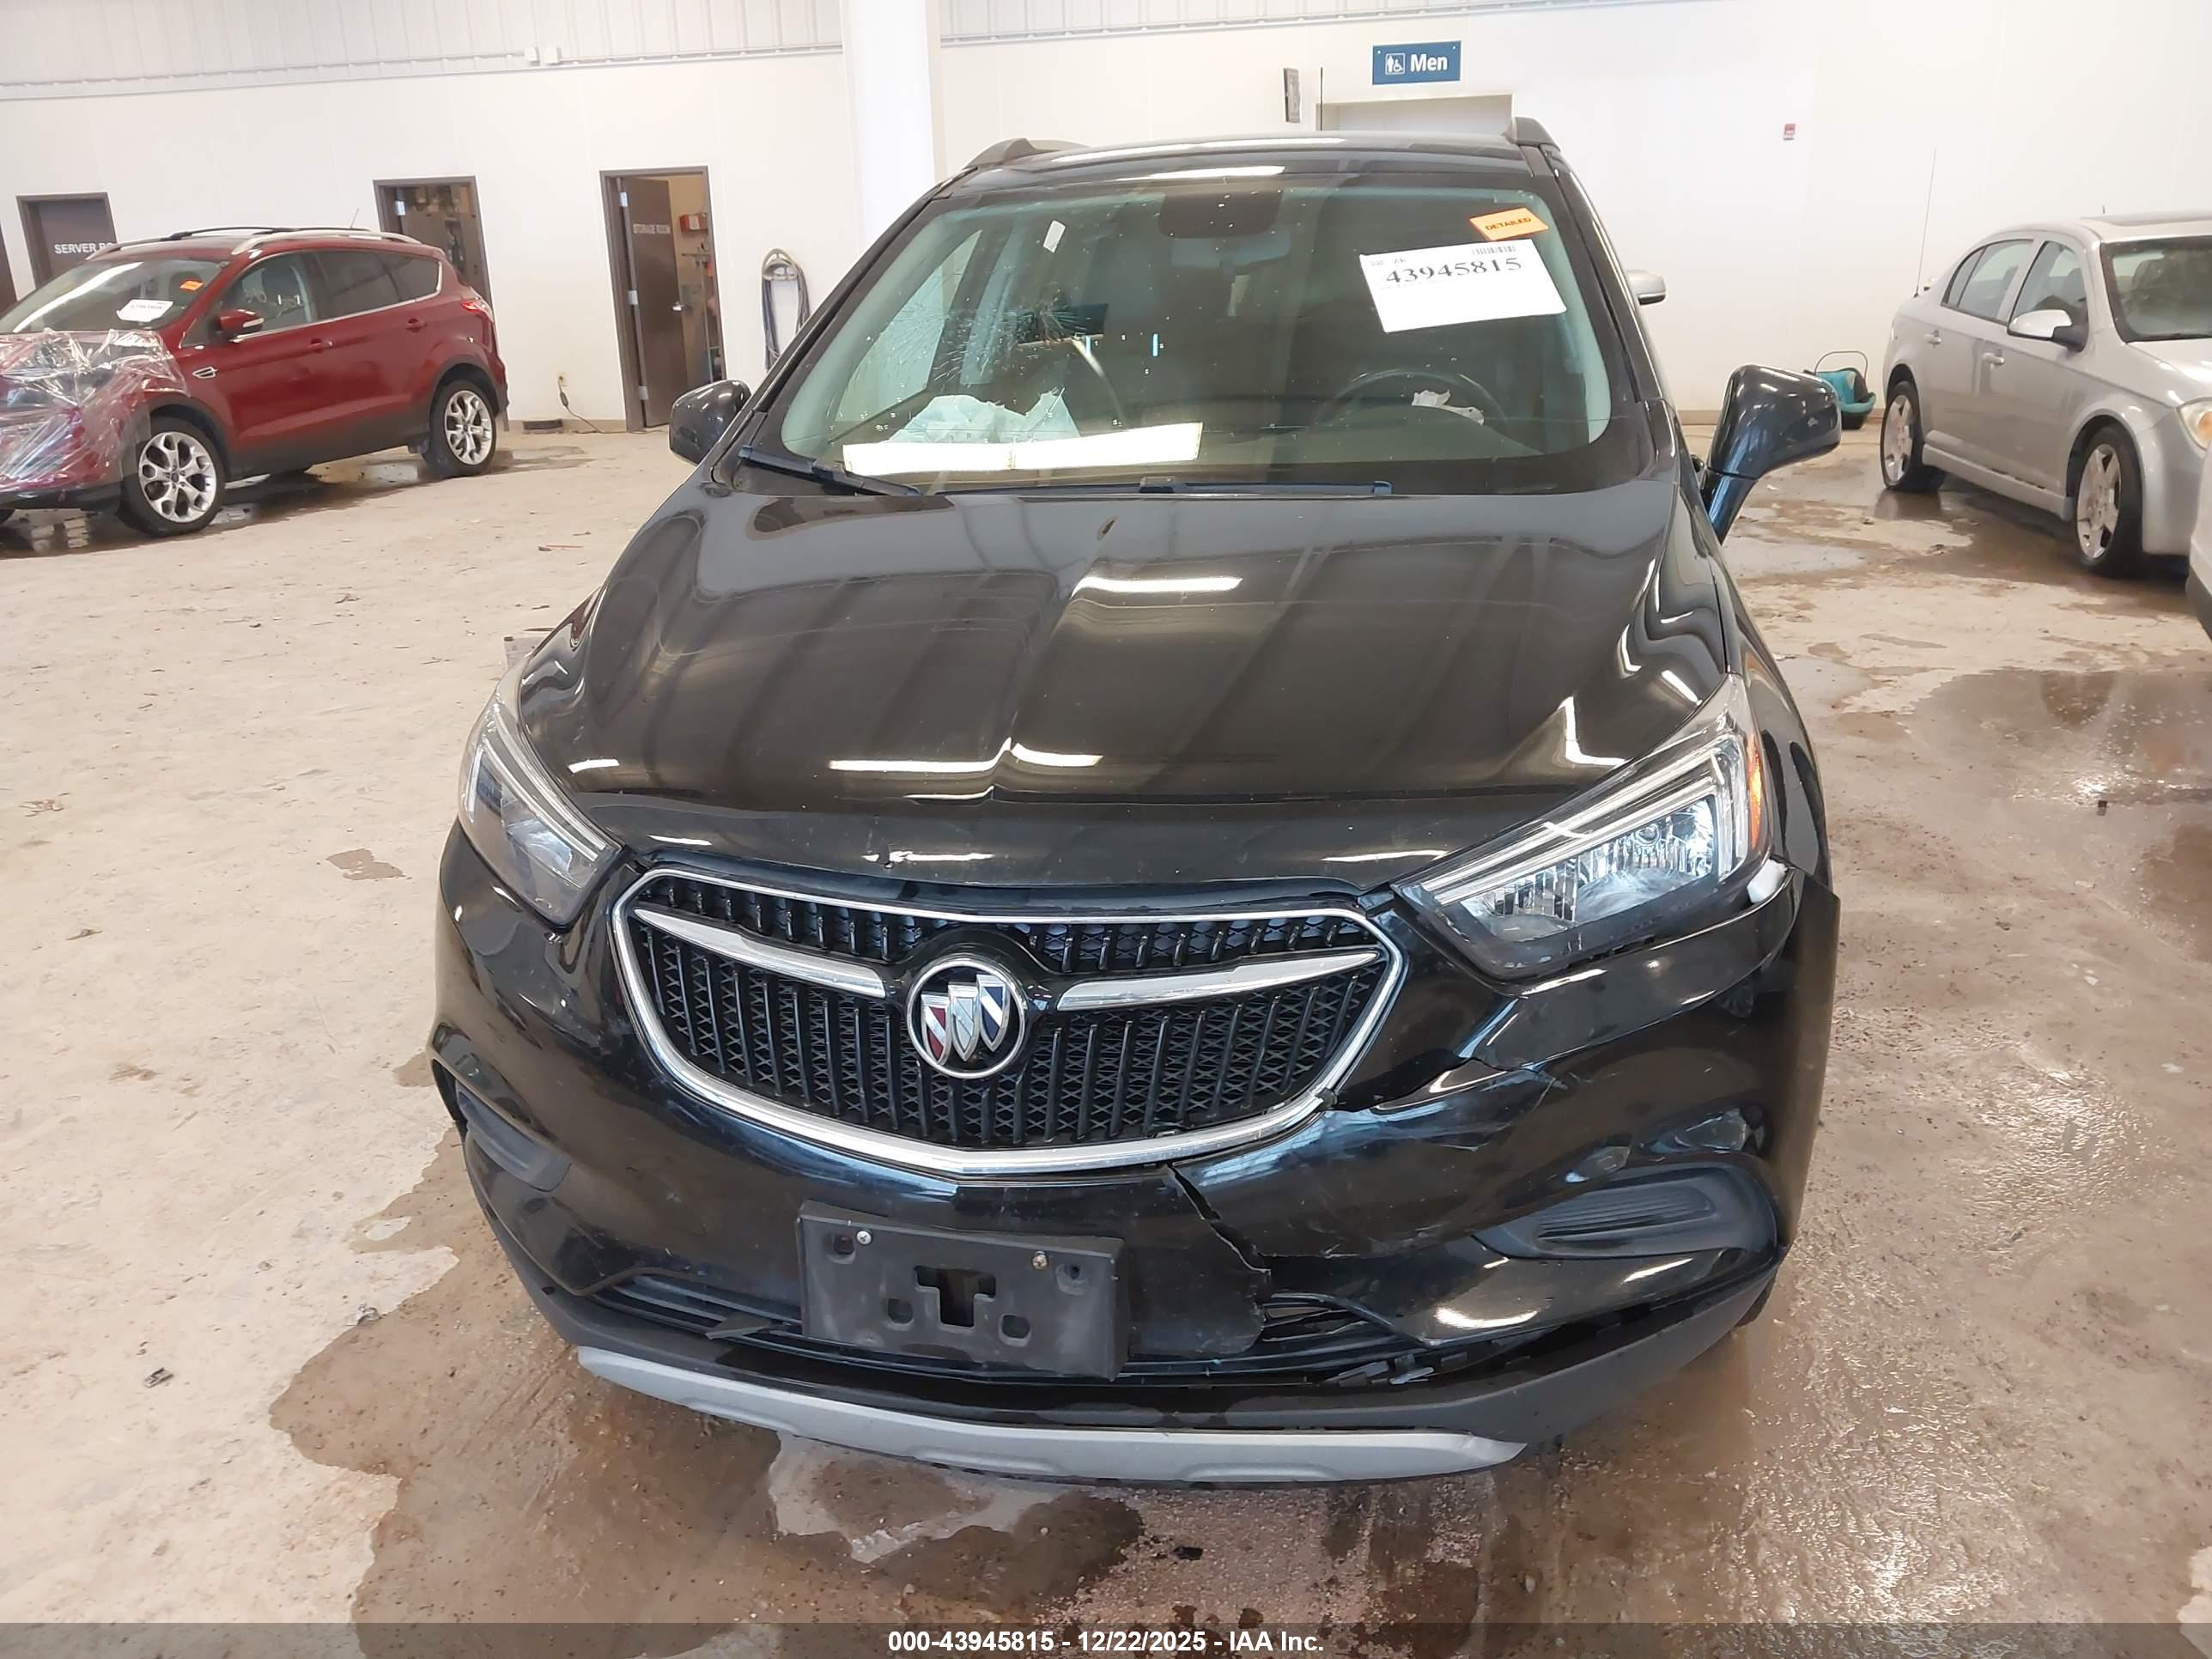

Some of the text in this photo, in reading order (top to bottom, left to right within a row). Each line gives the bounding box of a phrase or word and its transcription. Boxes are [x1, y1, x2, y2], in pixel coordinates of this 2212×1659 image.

[1410, 53, 1448, 73] Men
[1485, 216, 1532, 231] DETAILED
[54, 242, 97, 254] SERVER
[1386, 257, 1522, 283] 43945815
